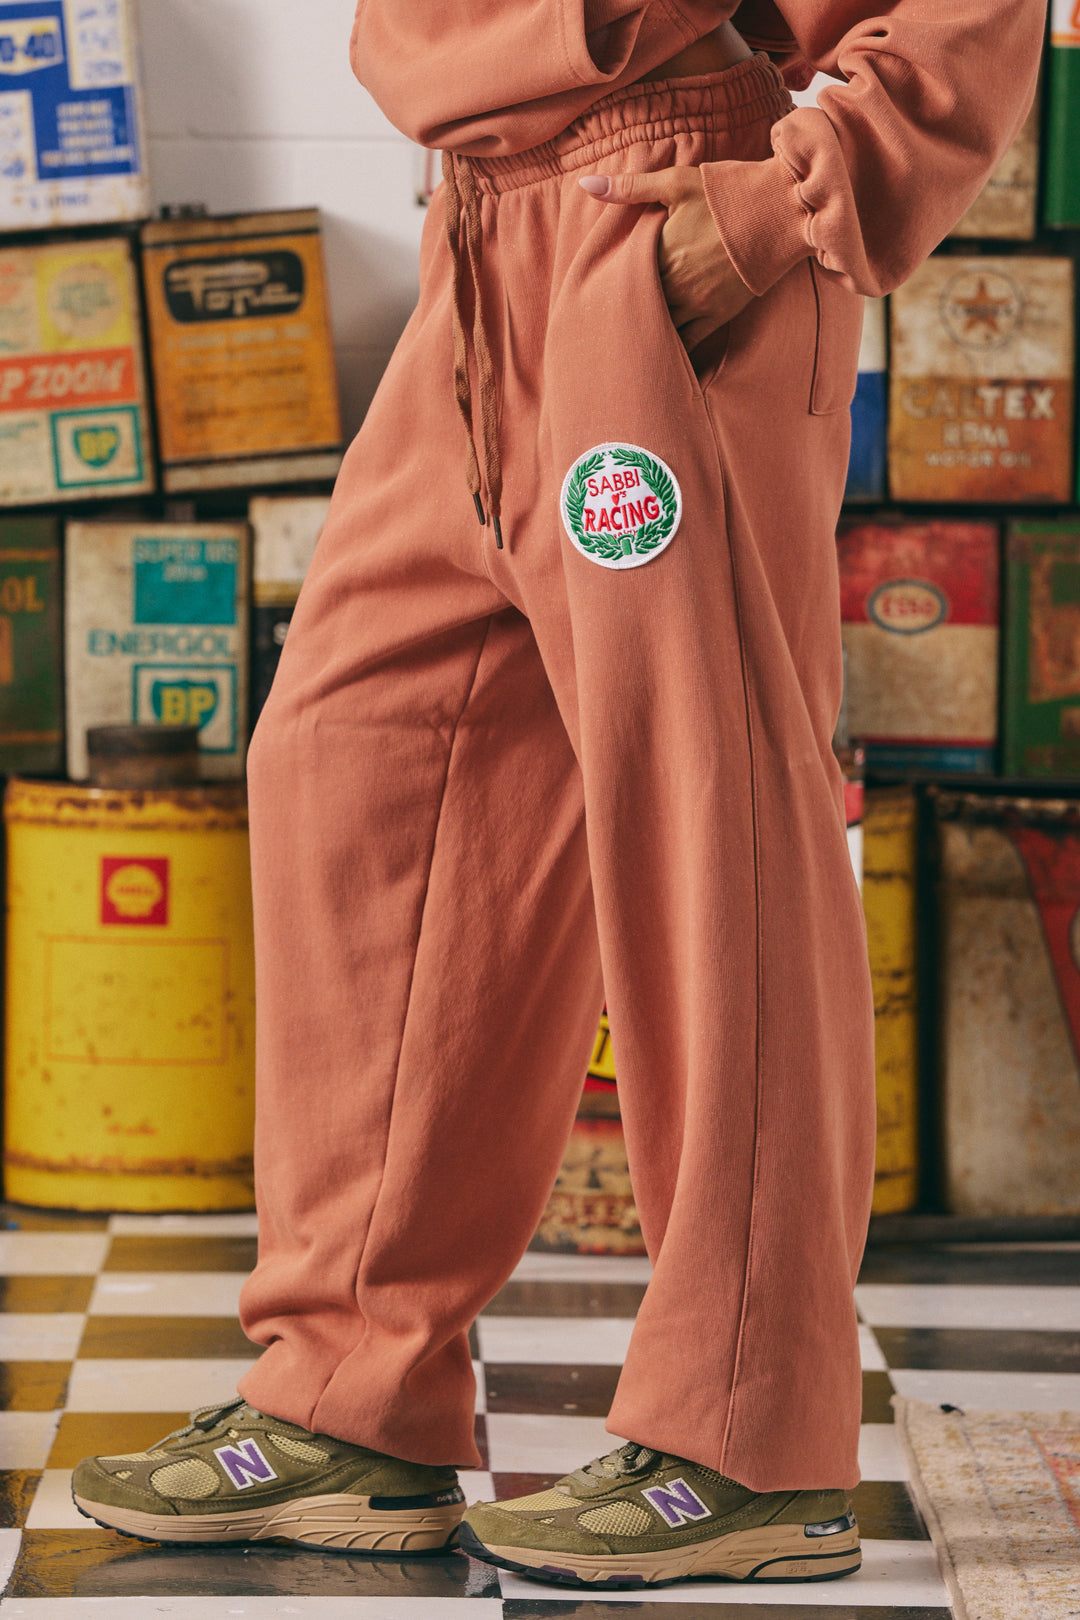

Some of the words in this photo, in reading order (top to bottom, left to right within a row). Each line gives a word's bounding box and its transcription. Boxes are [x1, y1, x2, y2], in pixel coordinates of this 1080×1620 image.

[27, 357, 125, 400] ZOOM
[901, 383, 1057, 420] CALTEX
[77, 430, 118, 461] BP
[587, 468, 641, 498] SABBI
[583, 495, 661, 533] RACING
[88, 630, 232, 658] ENERGOL
[160, 686, 215, 727] BP
